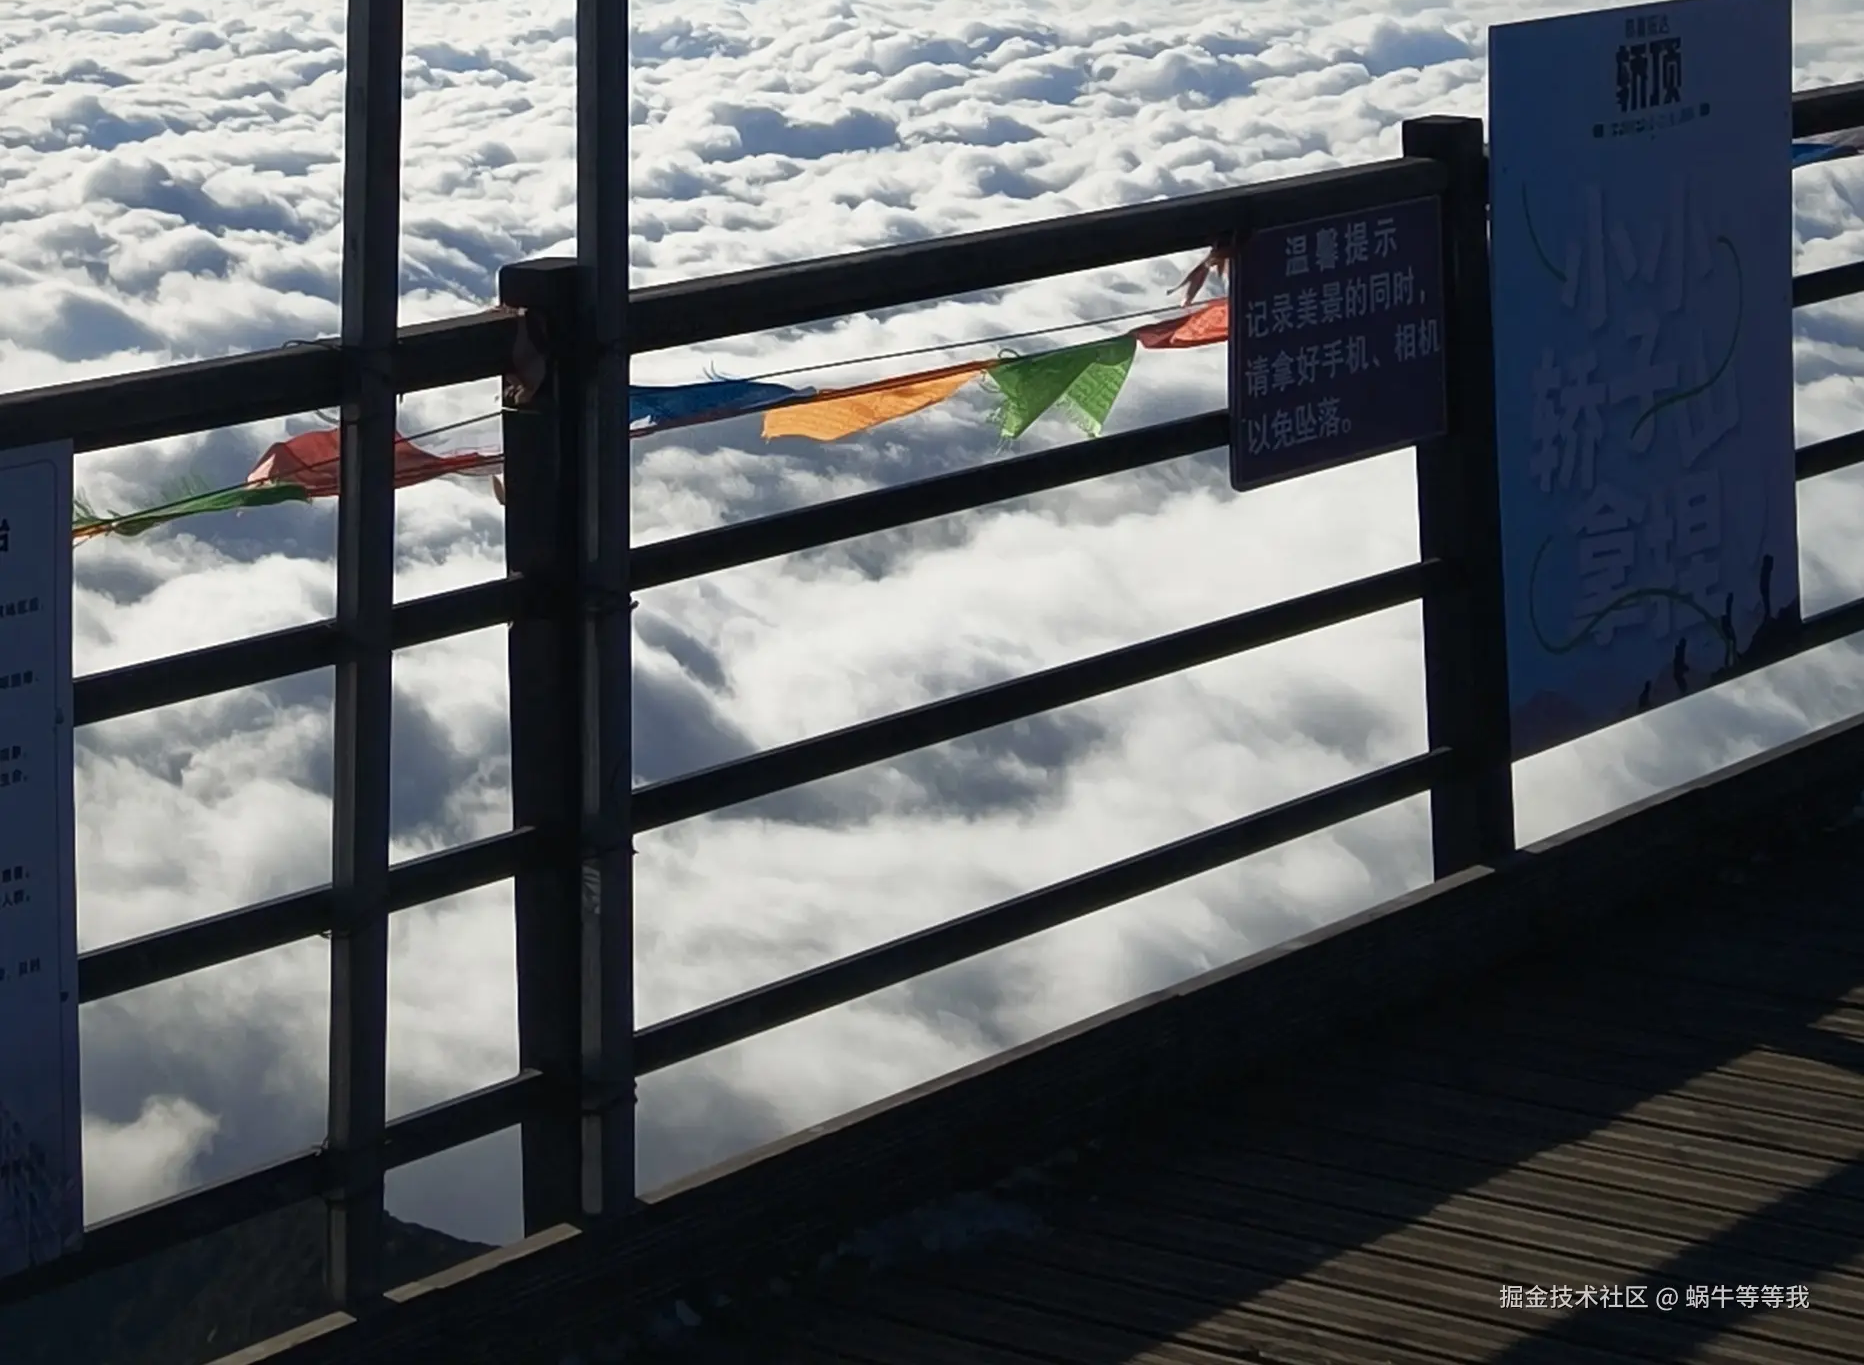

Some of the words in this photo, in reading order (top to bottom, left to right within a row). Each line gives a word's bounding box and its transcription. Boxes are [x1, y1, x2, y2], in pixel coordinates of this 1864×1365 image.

[1616, 37, 1682, 113] 轿顶
[1284, 218, 1398, 277] 温馨提示
[1562, 173, 1713, 331] 小小
[1245, 266, 1427, 338] 记录美景的同时，
[1245, 318, 1442, 399] 请拿好手机、相机
[1246, 396, 1352, 456] 以免坠落。
[1529, 308, 1739, 492] 轿子山
